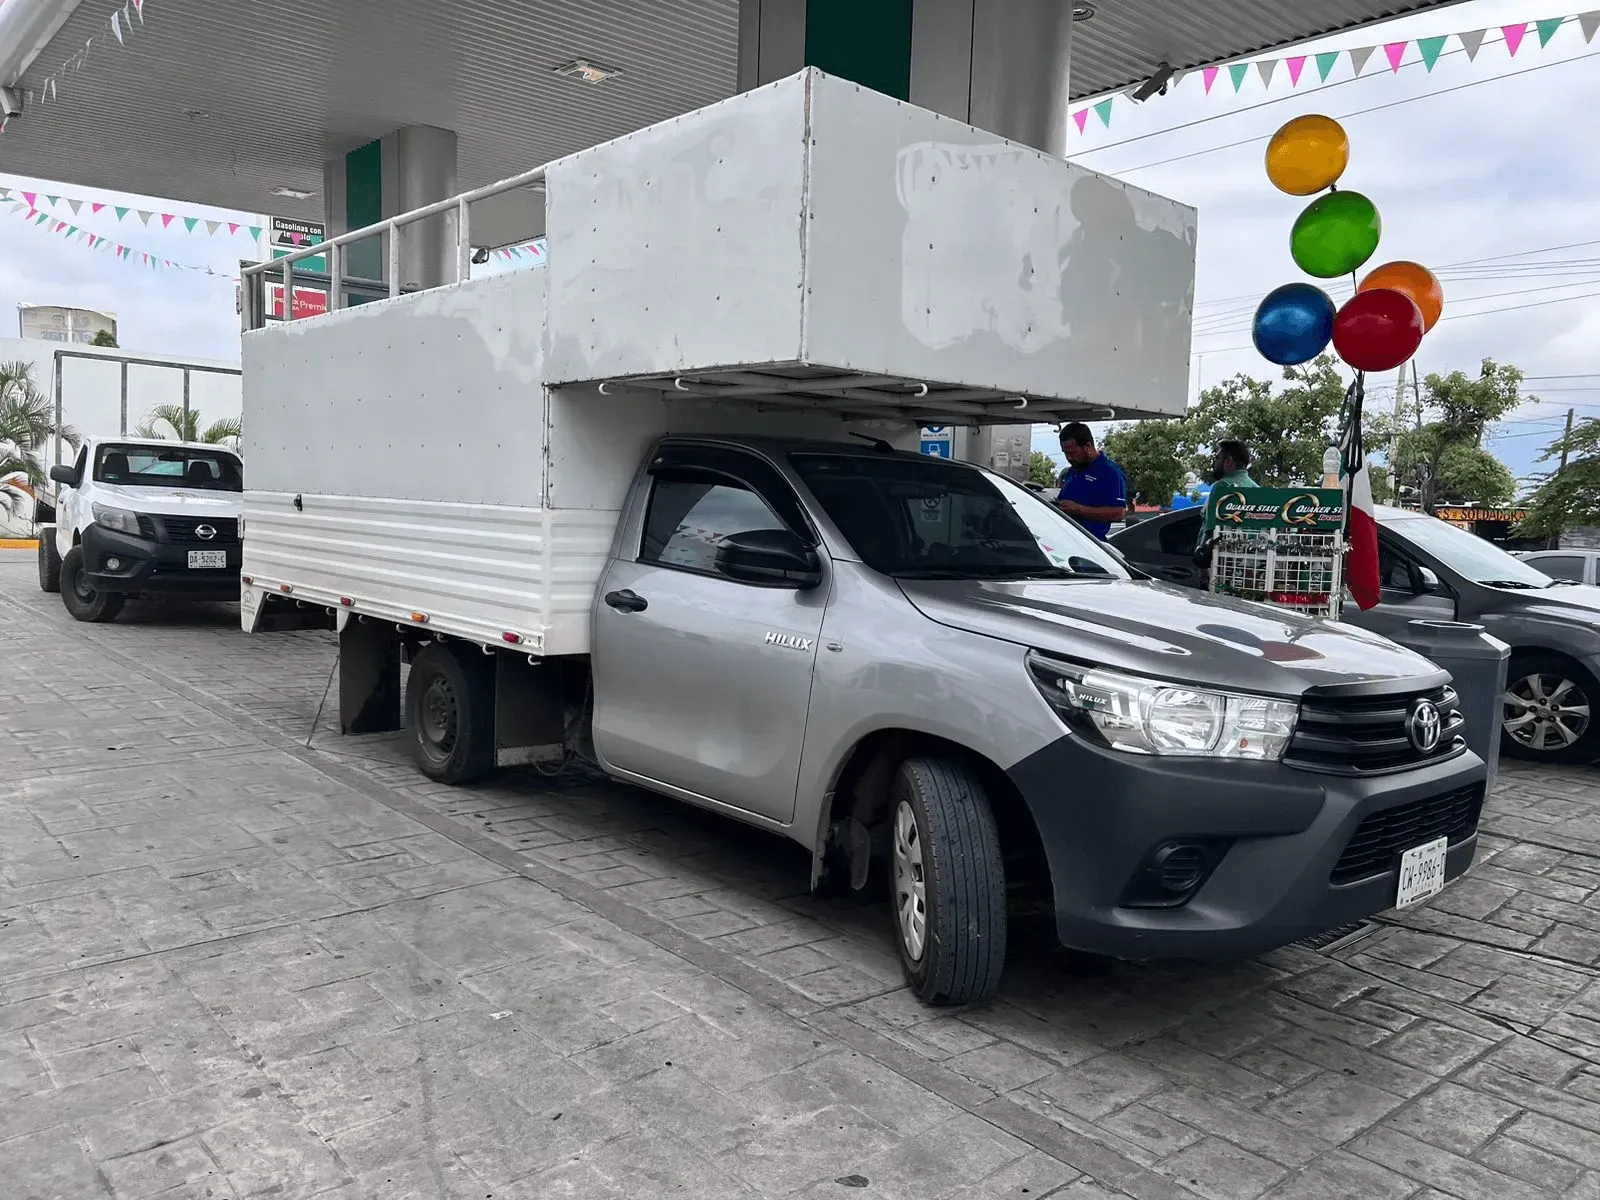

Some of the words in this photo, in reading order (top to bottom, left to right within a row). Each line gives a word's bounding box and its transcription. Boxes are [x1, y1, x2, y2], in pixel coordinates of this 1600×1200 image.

[275, 220, 309, 232] Gasolinas
[310, 227, 322, 235] con
[1225, 503, 1256, 513] QUAKER
[1257, 505, 1281, 513] STATE
[764, 631, 813, 652] HILUX
[1079, 693, 1108, 705] HILUX
